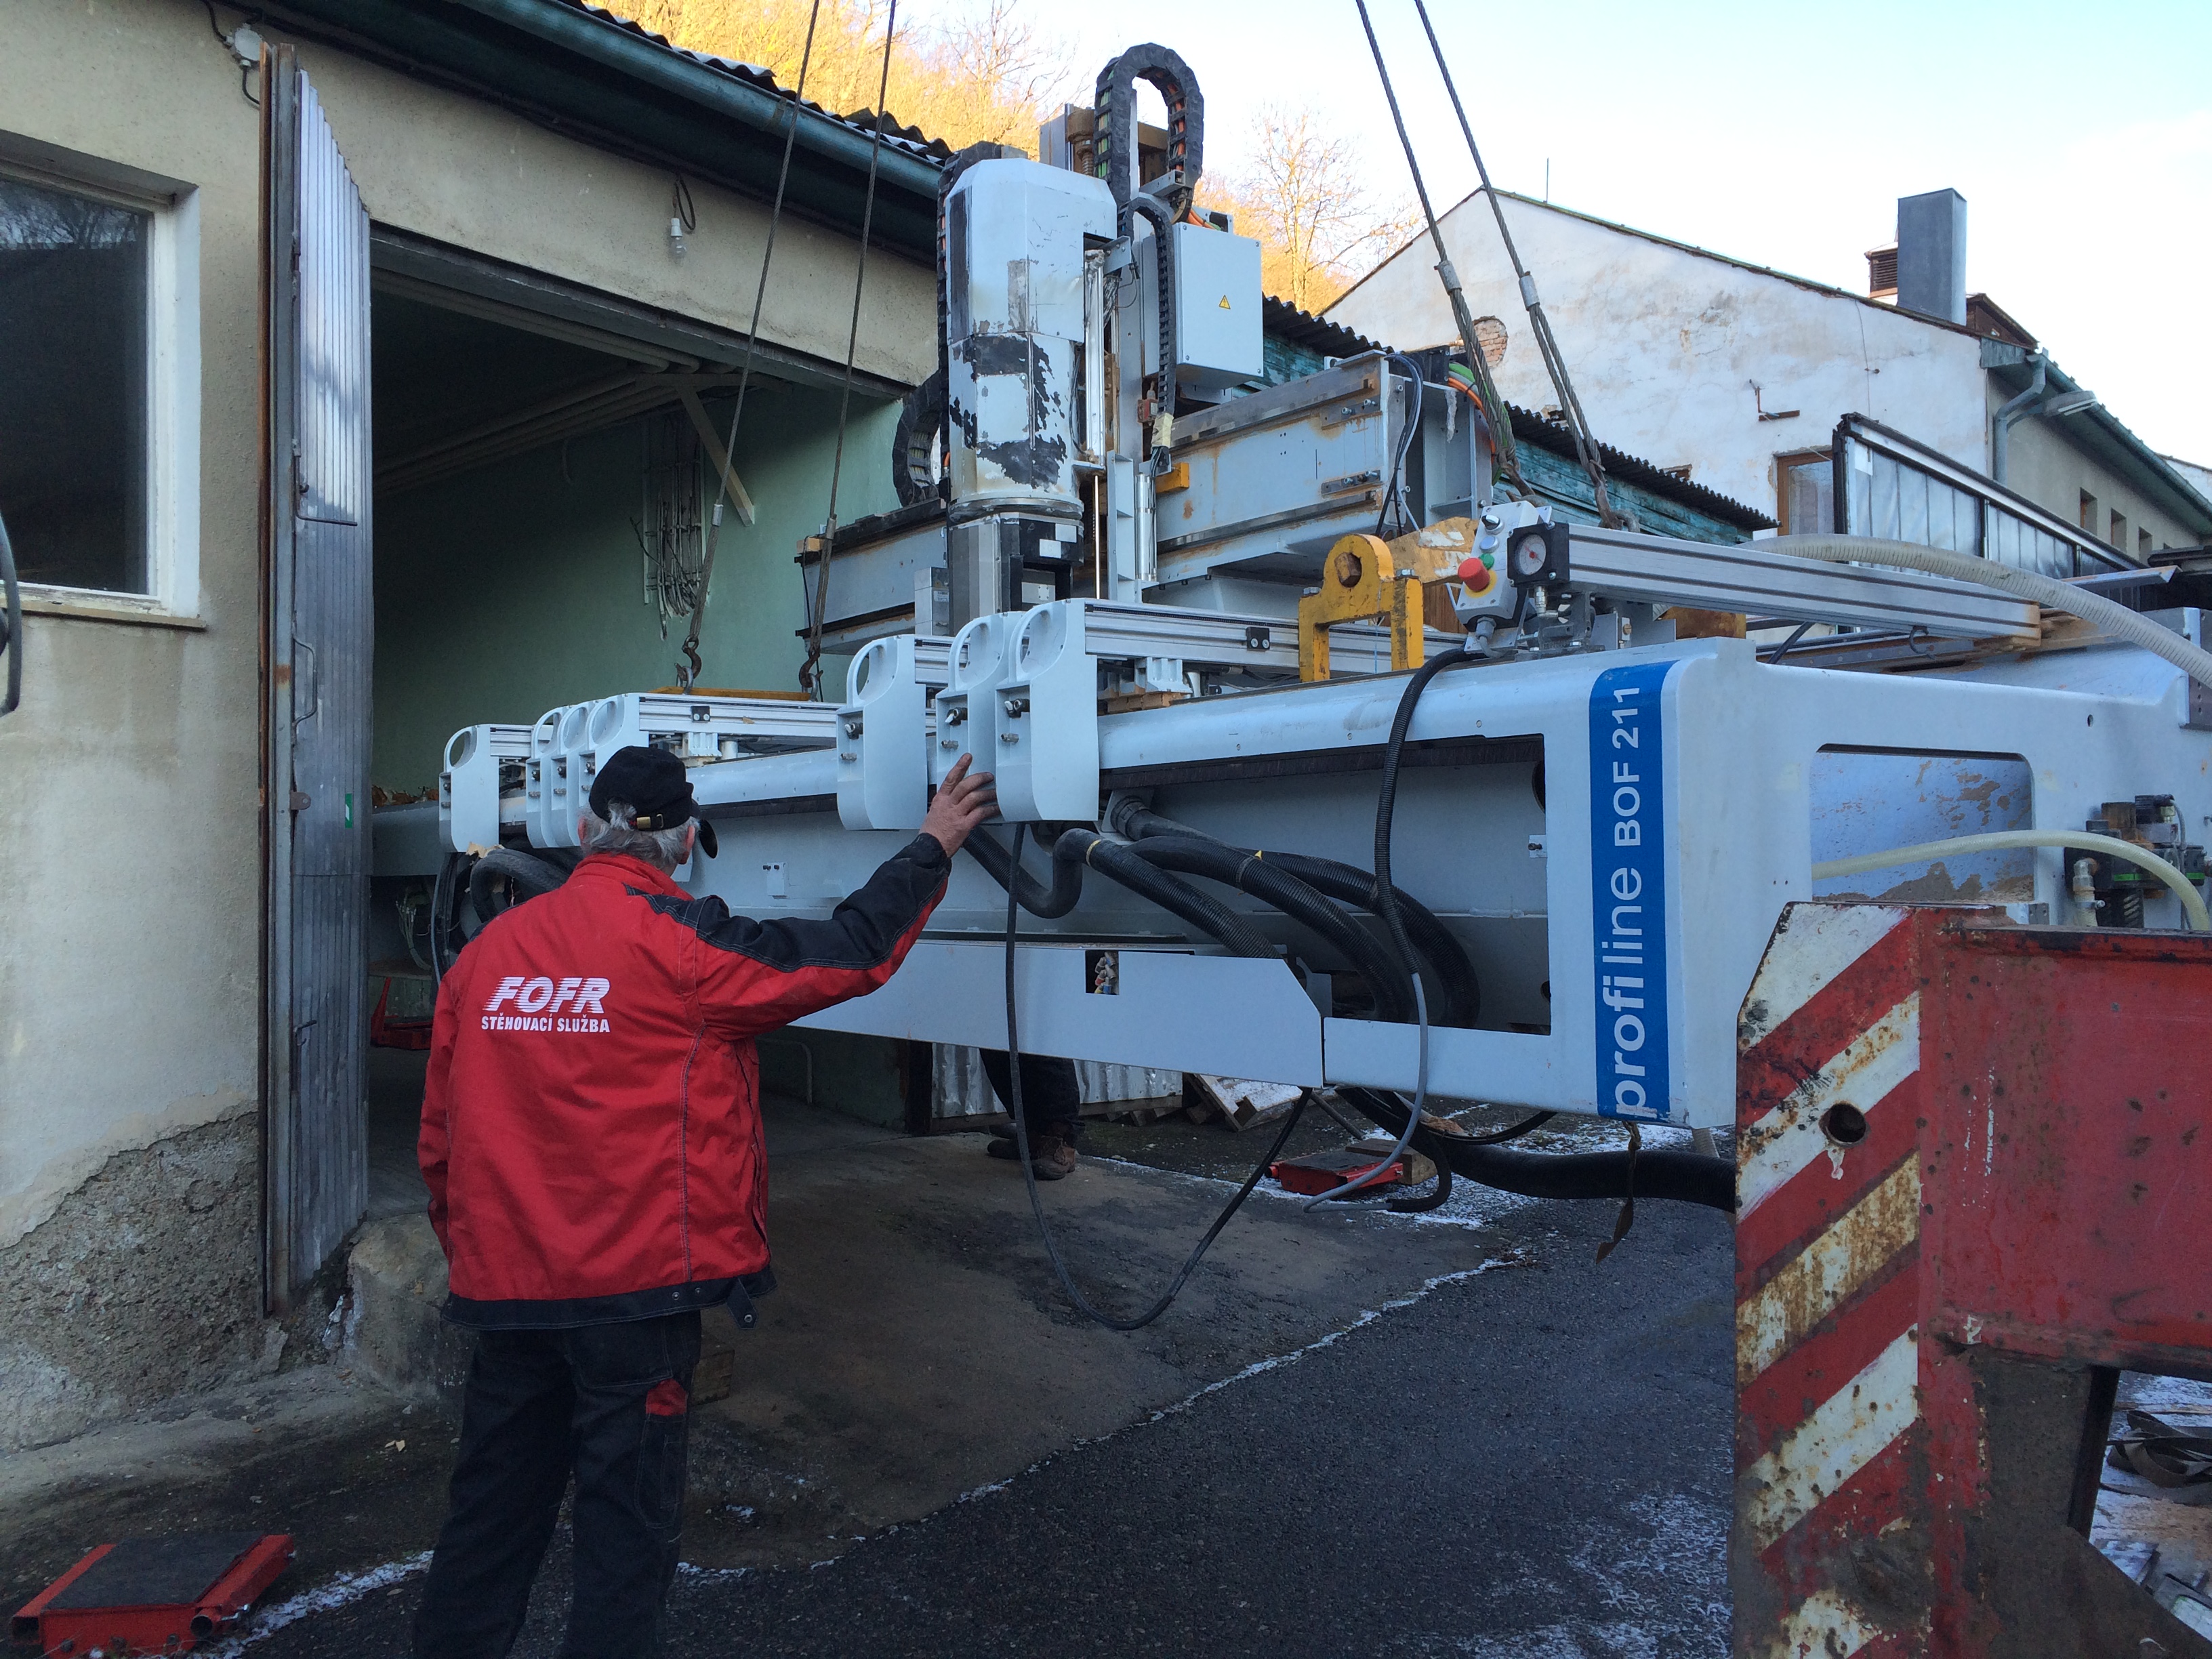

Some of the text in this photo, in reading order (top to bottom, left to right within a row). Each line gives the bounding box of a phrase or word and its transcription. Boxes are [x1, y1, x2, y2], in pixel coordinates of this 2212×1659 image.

[1612, 688, 1640, 749] 211
[1612, 761, 1641, 846] BOF
[482, 976, 611, 1013] FOFR
[481, 1012, 611, 1033] STĚHOVACÍ SLUŽBA
